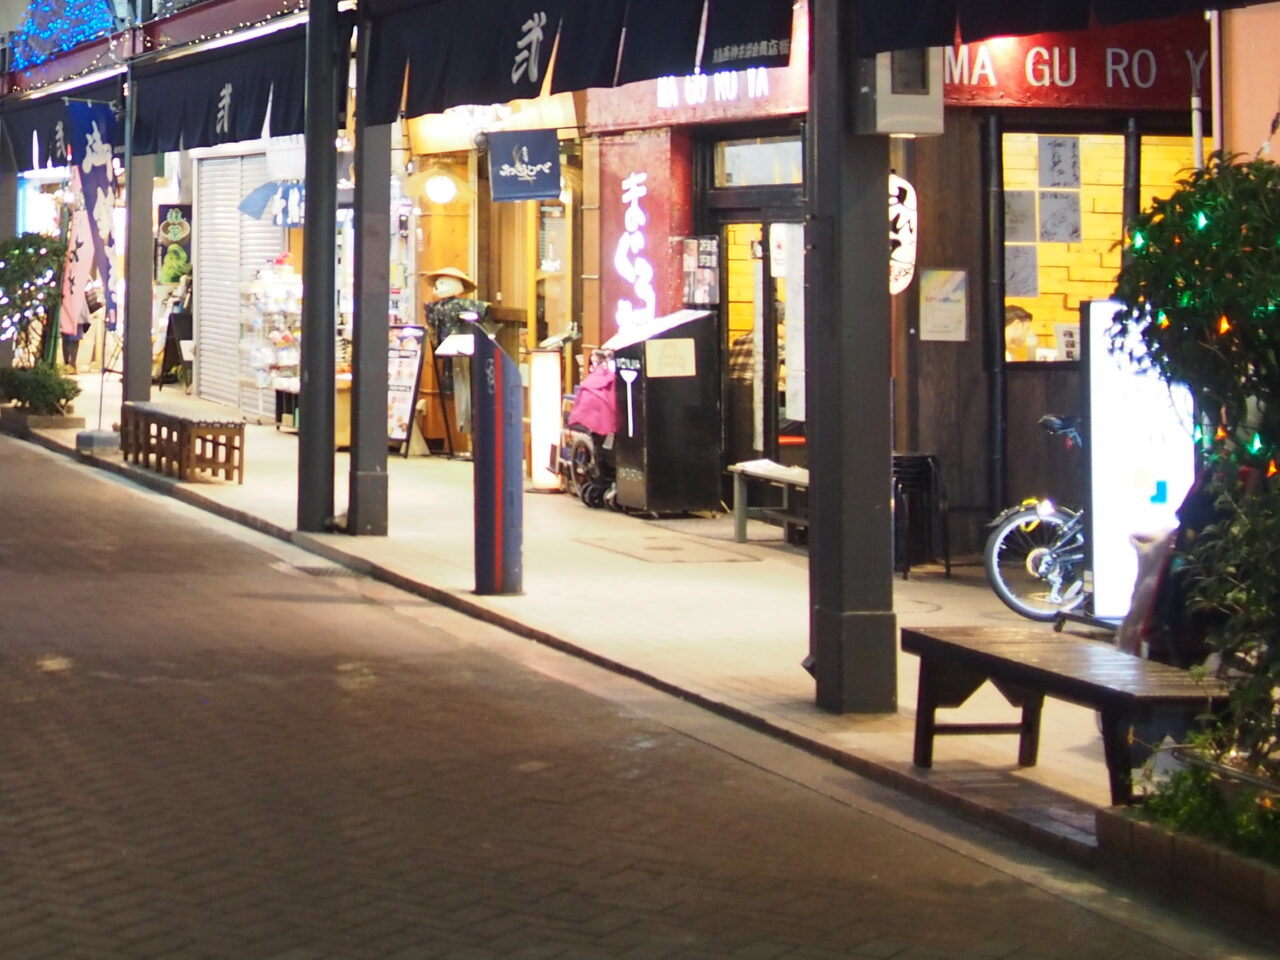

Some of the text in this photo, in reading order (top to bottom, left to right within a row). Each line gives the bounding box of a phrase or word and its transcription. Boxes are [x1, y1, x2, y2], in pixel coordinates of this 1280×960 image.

[944, 44, 998, 88] MA
[1025, 46, 1077, 88] GU
[1106, 48, 1157, 88] RO
